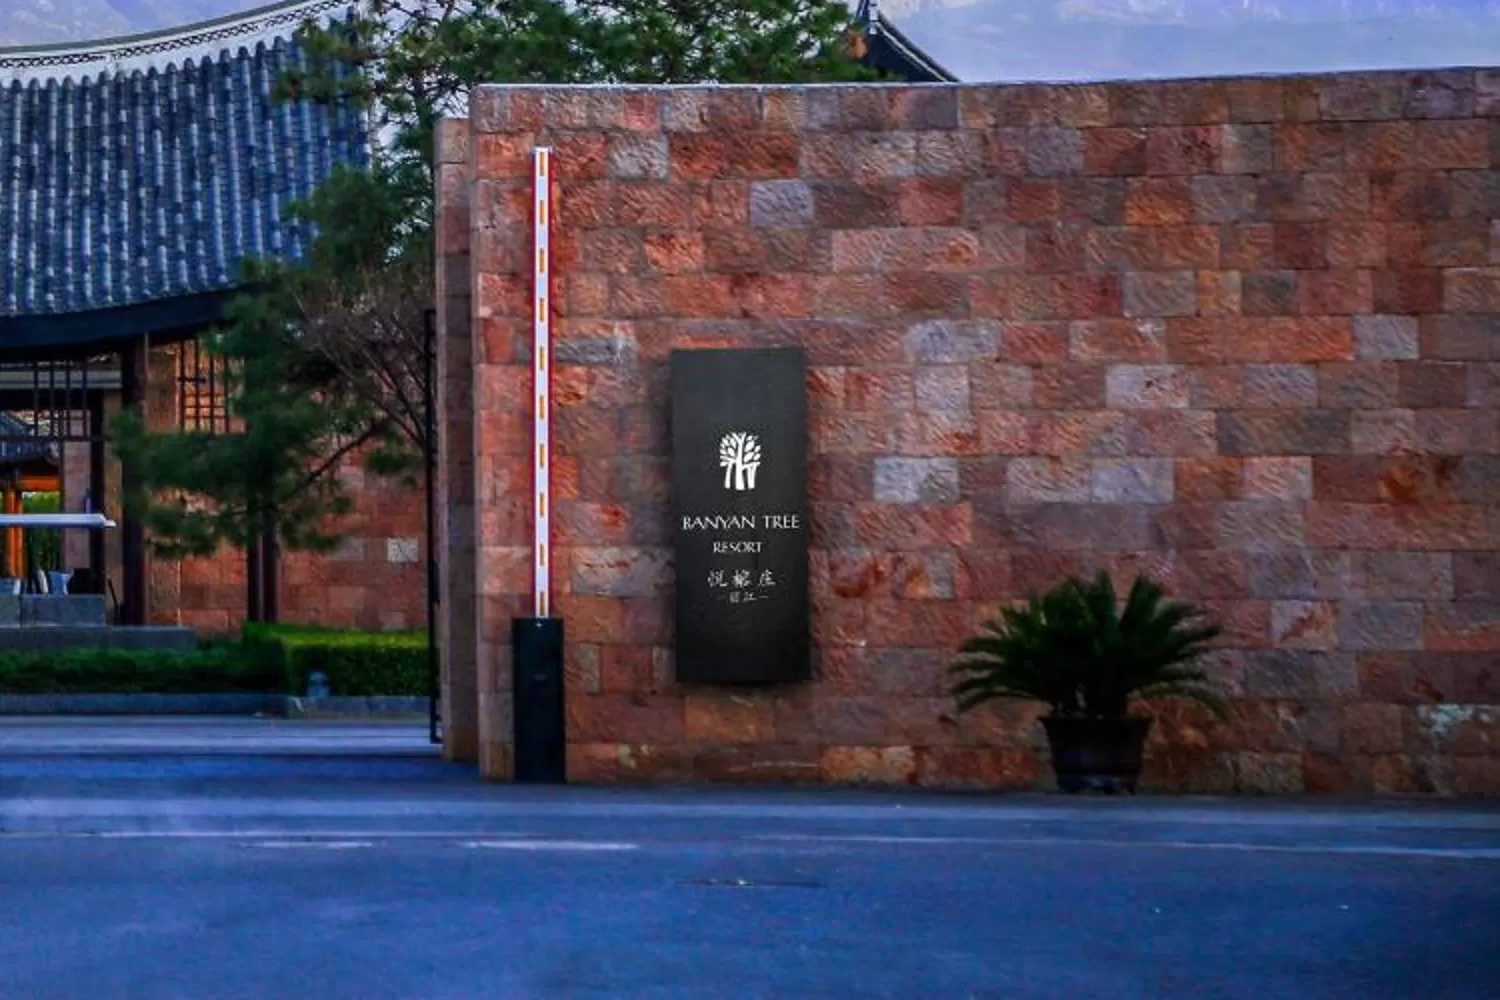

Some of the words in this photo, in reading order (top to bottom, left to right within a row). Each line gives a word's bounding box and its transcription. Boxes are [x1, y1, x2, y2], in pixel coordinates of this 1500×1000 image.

[682, 515, 755, 530] BANYAN
[762, 515, 800, 529] TREE
[713, 541, 763, 553] RESORT
